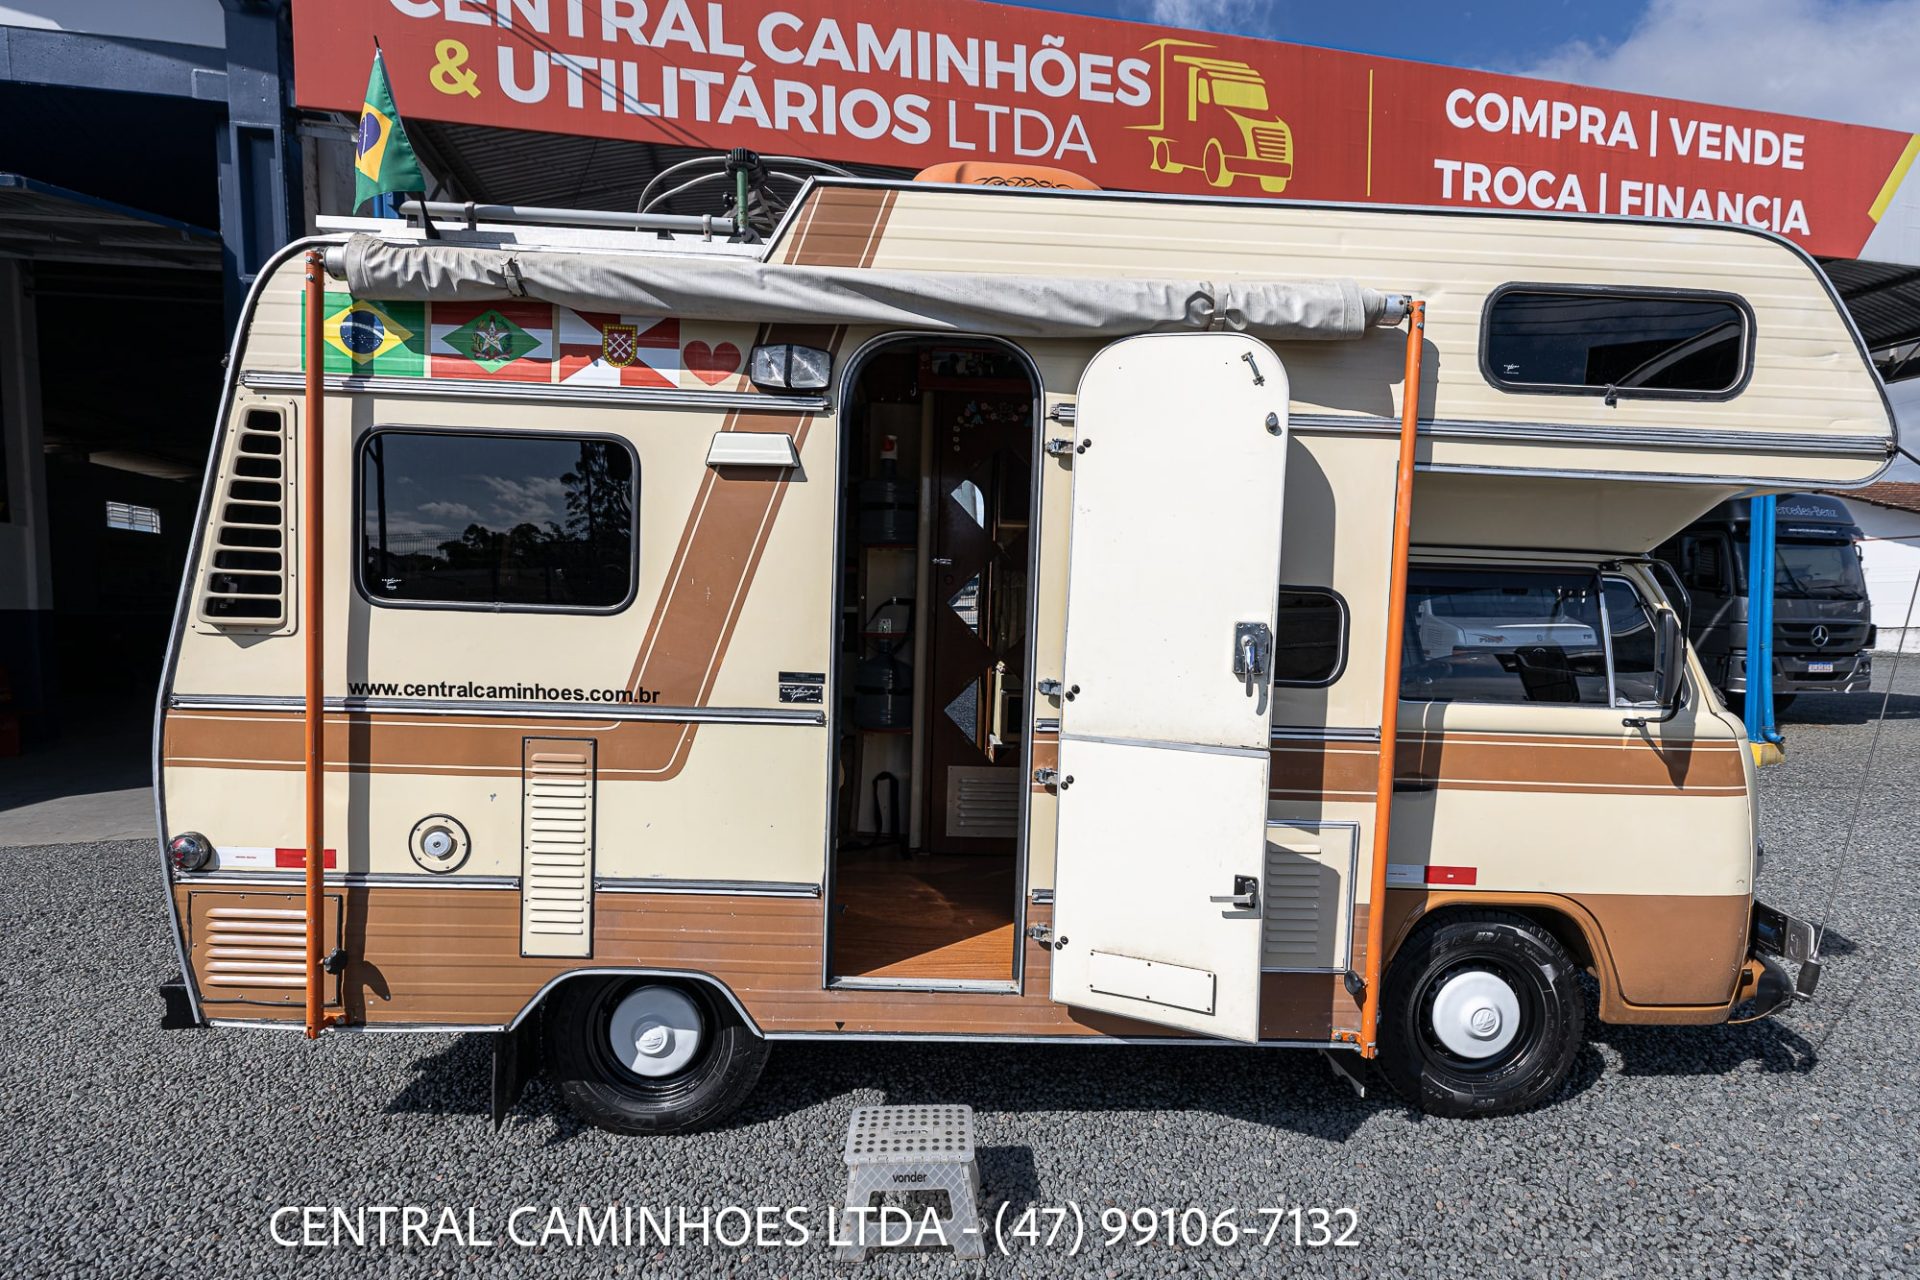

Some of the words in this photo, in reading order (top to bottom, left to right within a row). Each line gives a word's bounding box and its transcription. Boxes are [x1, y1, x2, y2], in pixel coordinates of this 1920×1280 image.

[757, 11, 1152, 107] CAMINHÕES
[429, 38, 482, 99] &
[497, 45, 931, 145] UTILITÁRIOS
[948, 100, 1098, 164] LTDA
[1445, 88, 1639, 150] COMPRA
[1668, 117, 1806, 171] VENDE
[1433, 158, 1588, 214] TROCA
[1619, 180, 1812, 236] FINANCIA
[1776, 504, 1838, 518] ercedes-Benz
[347, 681, 661, 704] www.centralcaminhoes.com.br
[892, 1170, 928, 1183] vonder
